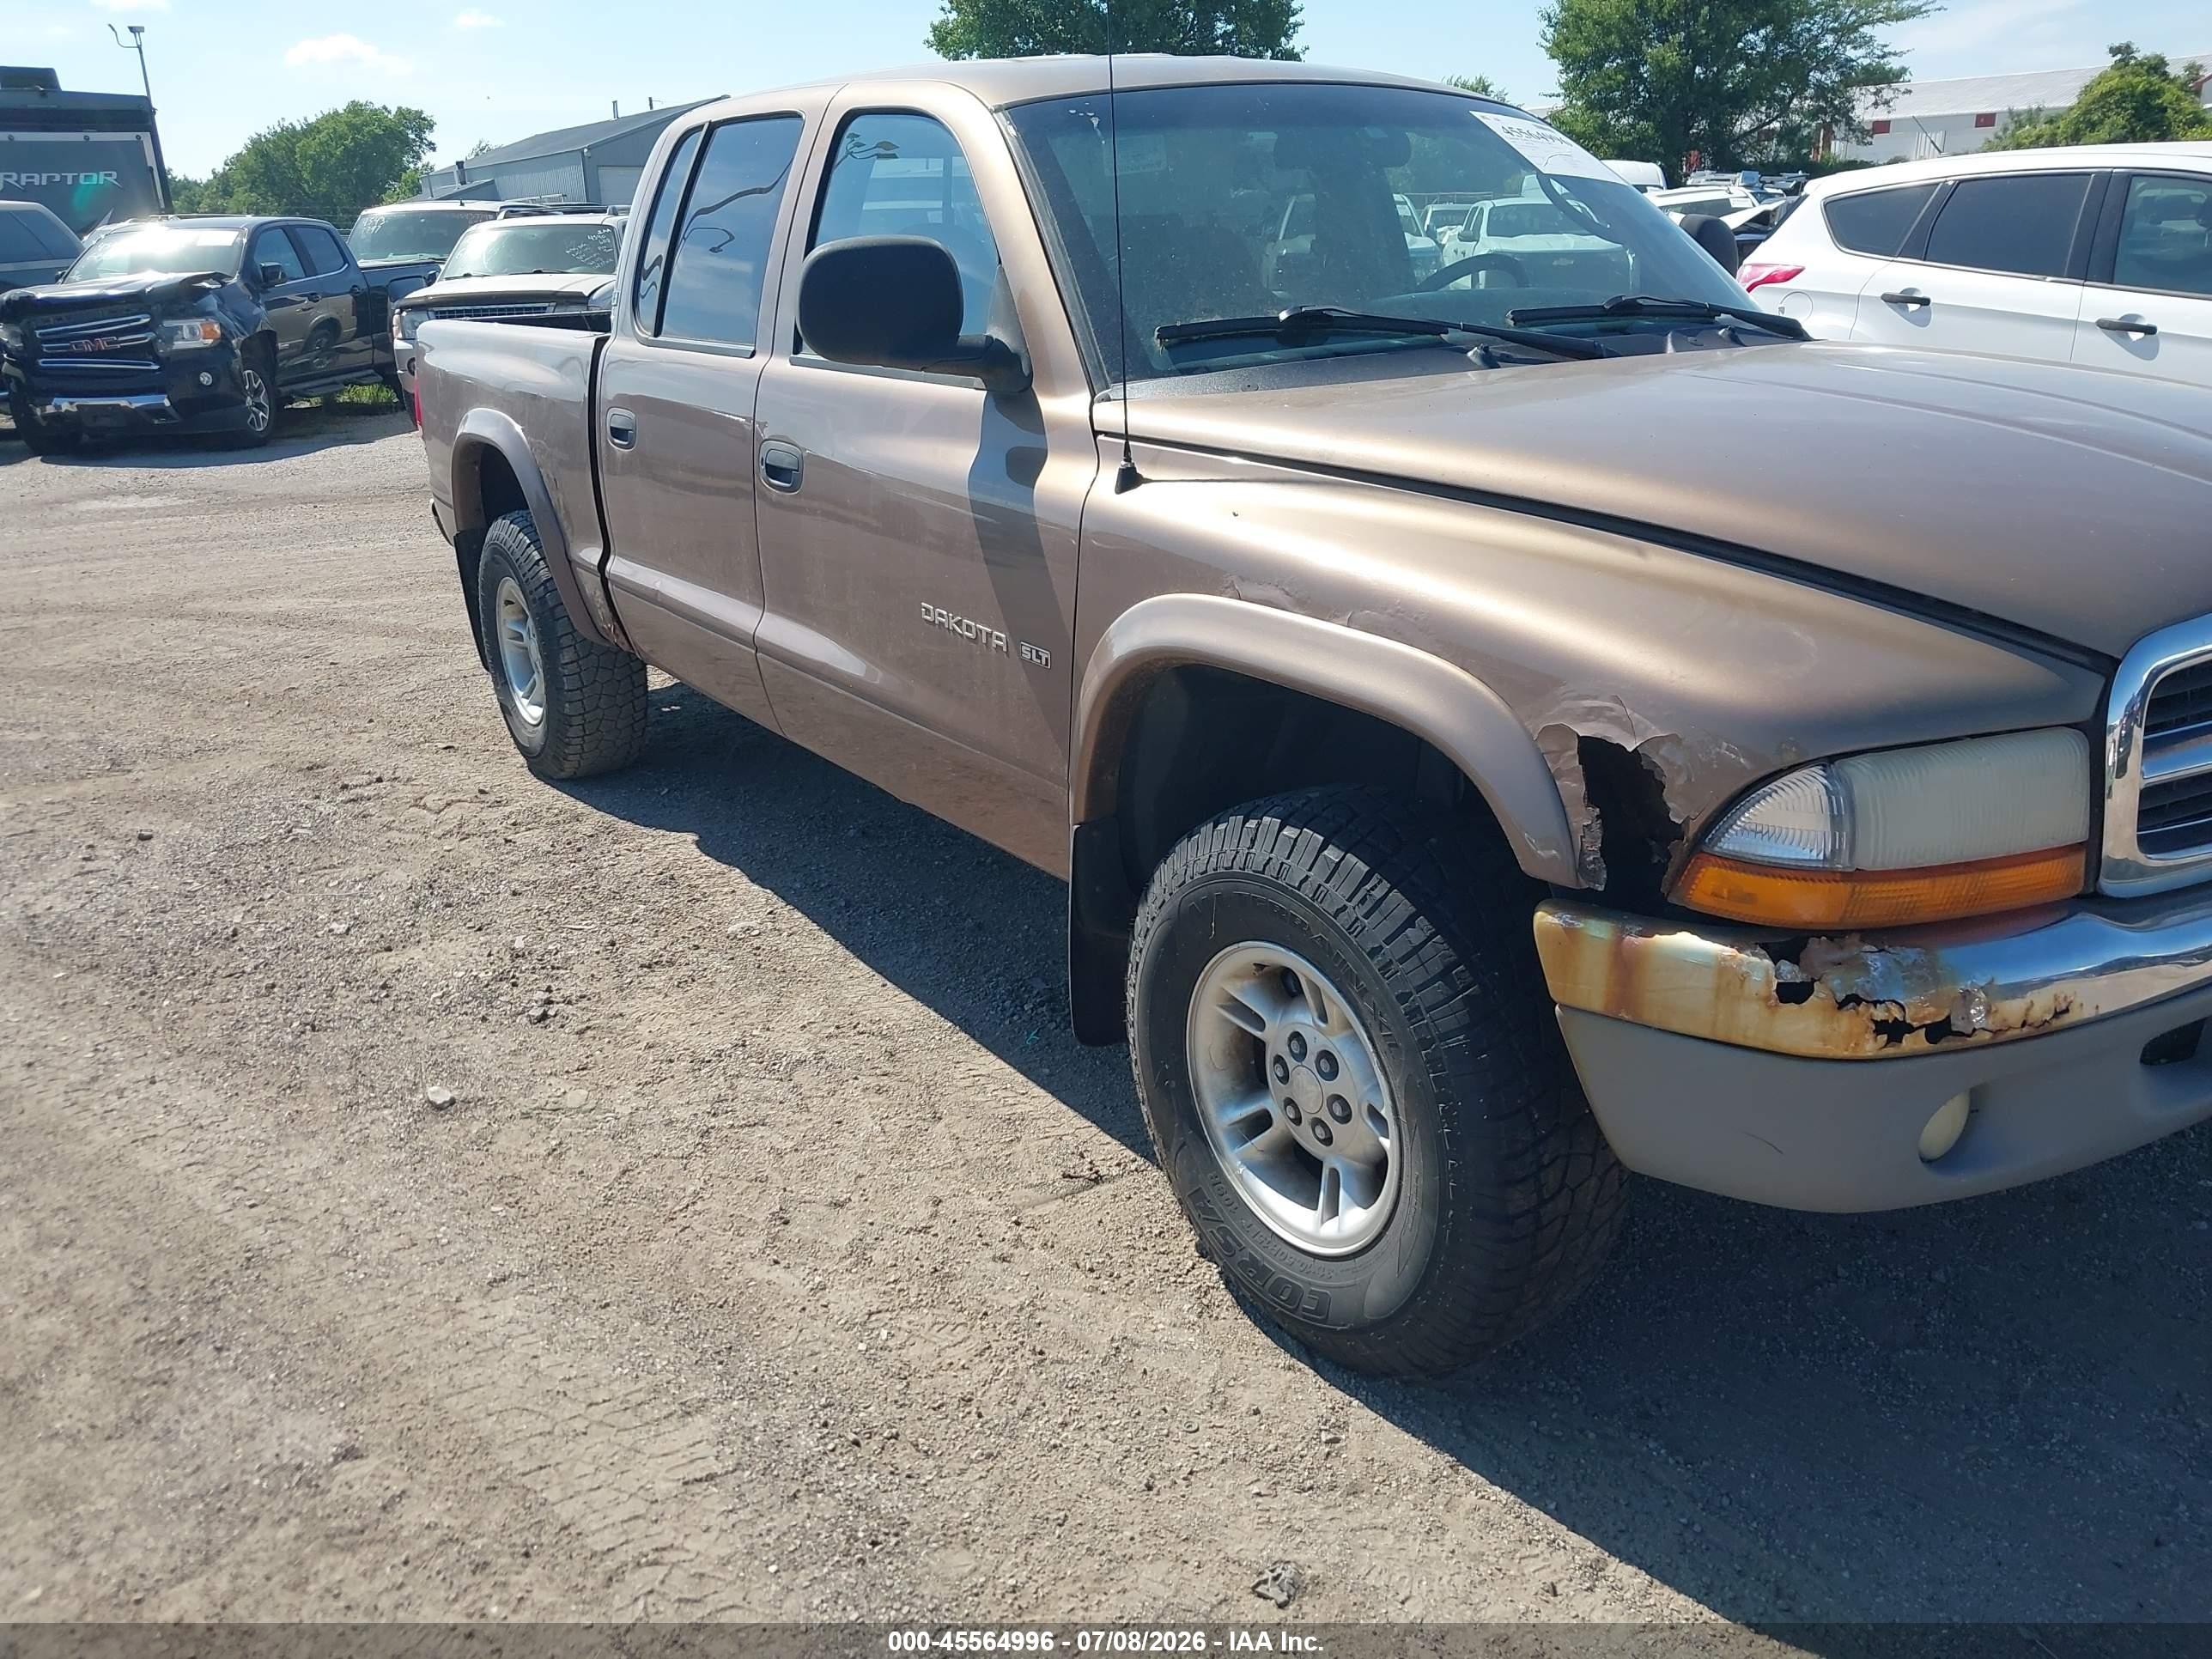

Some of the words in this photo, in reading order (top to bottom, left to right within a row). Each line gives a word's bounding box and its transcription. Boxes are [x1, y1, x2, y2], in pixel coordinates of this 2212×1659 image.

[0, 171, 123, 191] RAPTOR
[69, 336, 121, 353] GMC
[921, 602, 1008, 653] DAKOTA
[1021, 645, 1050, 667] SLT
[1187, 1187, 1332, 1319] CORSA
